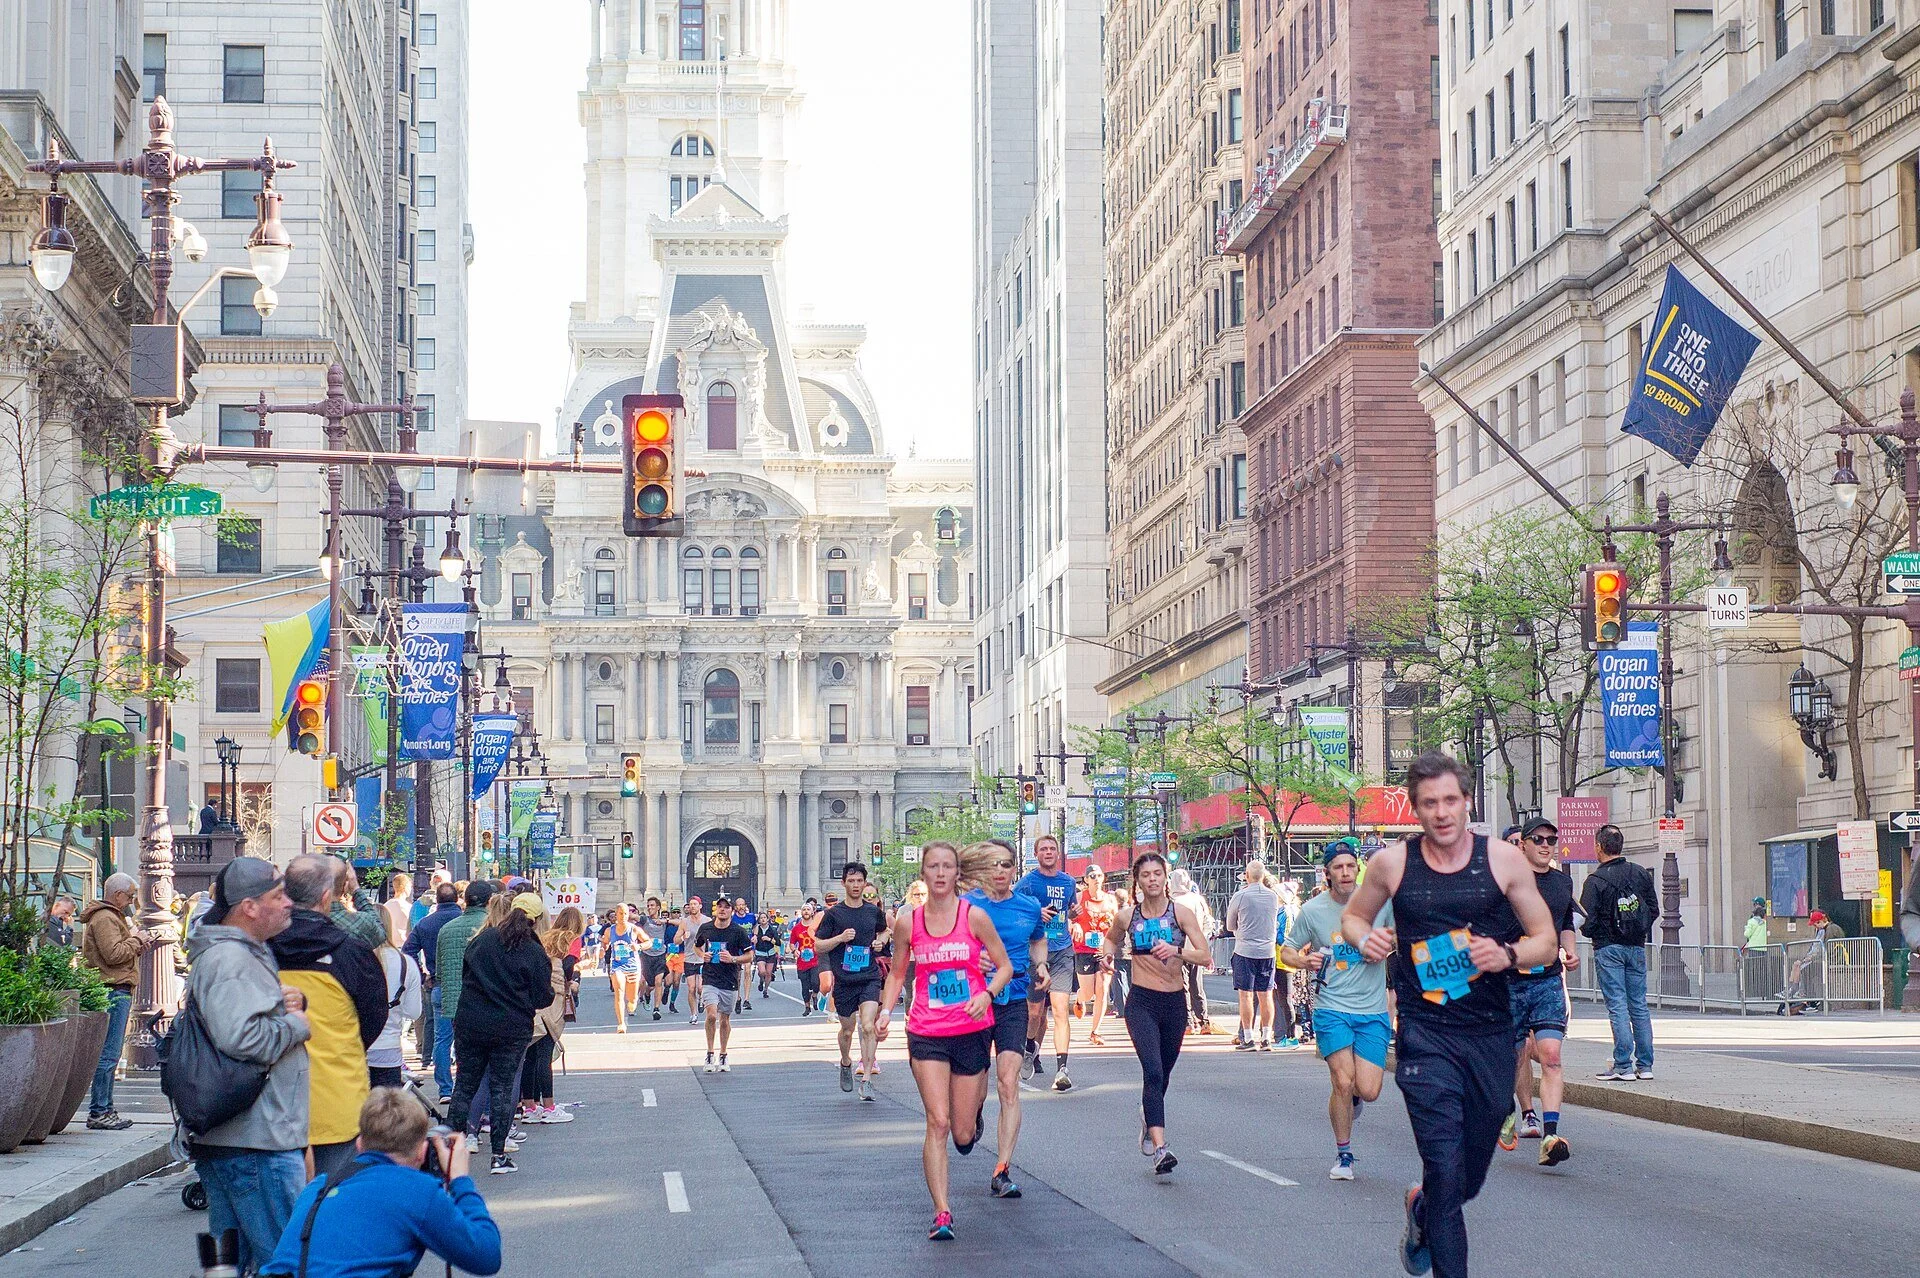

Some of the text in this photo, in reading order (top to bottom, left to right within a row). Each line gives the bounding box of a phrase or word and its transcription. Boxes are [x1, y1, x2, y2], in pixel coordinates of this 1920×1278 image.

[1746, 248, 1792, 301] FARGO
[1680, 322, 1712, 356] ONE
[1673, 335, 1706, 373] TWO
[1662, 351, 1710, 397] THREE
[1643, 383, 1691, 417] SO BROAD
[200, 500, 218, 514] ST
[1887, 562, 1920, 573] WALN
[1903, 579, 1920, 588] ONE
[1717, 593, 1738, 606] NO
[1711, 610, 1746, 620] TURNS
[404, 638, 450, 660] Organ
[403, 658, 457, 677] donors
[1602, 655, 1648, 675] Organ
[1604, 673, 1659, 691] donors
[404, 690, 450, 704] heroes
[1617, 692, 1637, 702] are
[1609, 701, 1657, 717] heroes
[475, 732, 507, 746] Organ
[1609, 749, 1660, 760] donors1.org
[1050, 787, 1061, 796] NO
[560, 884, 577, 893] GO
[1047, 885, 1065, 899] RISE
[557, 894, 580, 904] ROB
[847, 953, 865, 963] 1901
[1426, 950, 1472, 980] 4598
[933, 982, 964, 999] 1941
